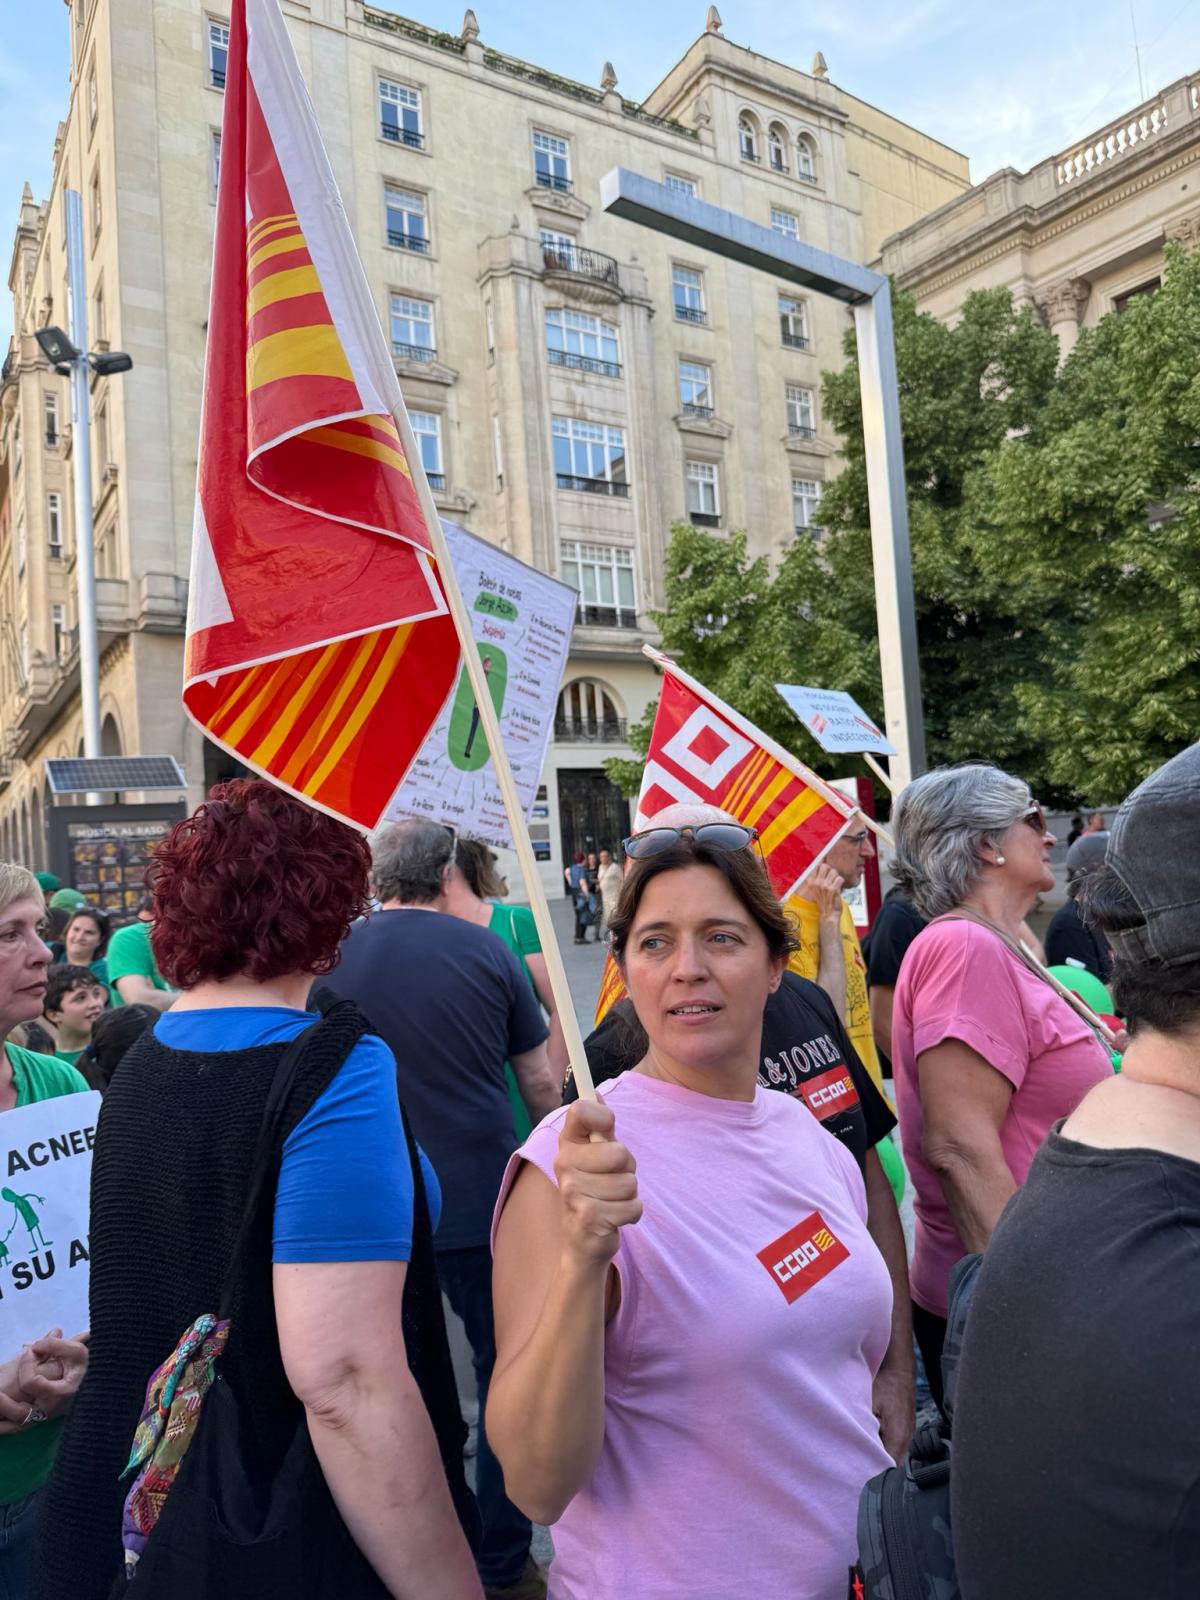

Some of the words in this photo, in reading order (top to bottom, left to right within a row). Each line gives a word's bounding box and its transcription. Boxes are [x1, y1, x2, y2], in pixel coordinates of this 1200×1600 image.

[808, 1080, 848, 1108] CCOO
[11, 1250, 56, 1291] SU
[773, 1240, 820, 1283] CCOO
